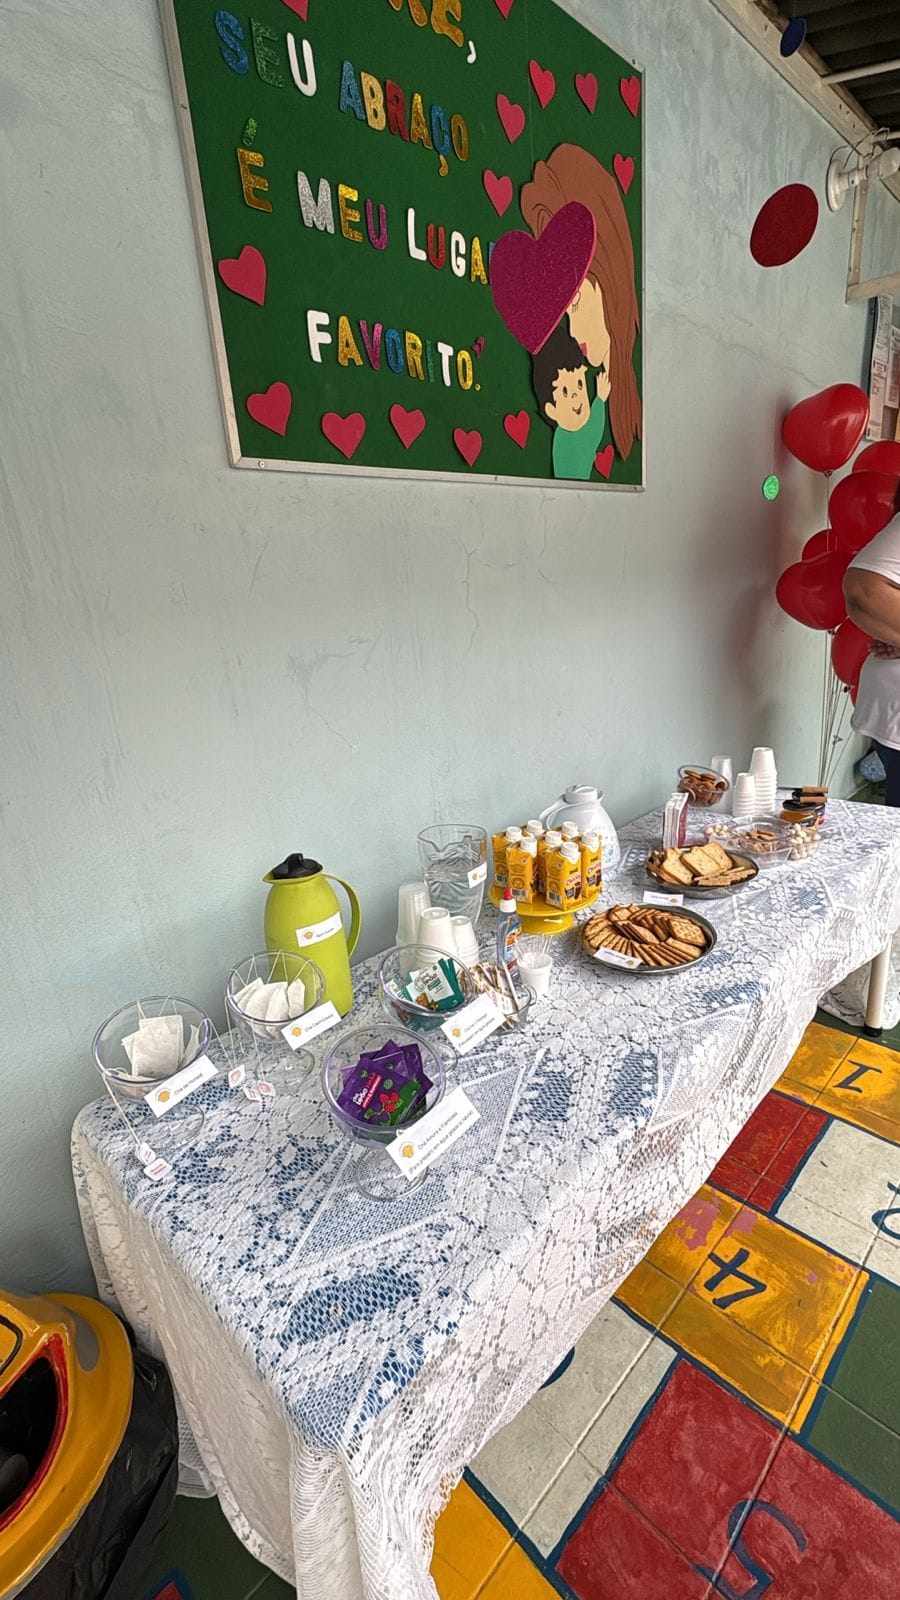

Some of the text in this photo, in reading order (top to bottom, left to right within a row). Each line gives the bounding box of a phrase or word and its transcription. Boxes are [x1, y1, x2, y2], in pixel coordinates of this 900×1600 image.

[214, 9, 470, 177] SEU ABRAÇO
[236, 117, 496, 285] É MEU LUGA
[833, 1059, 883, 1094] 1
[703, 1247, 768, 1310] 4
[692, 1498, 808, 1600] 5
